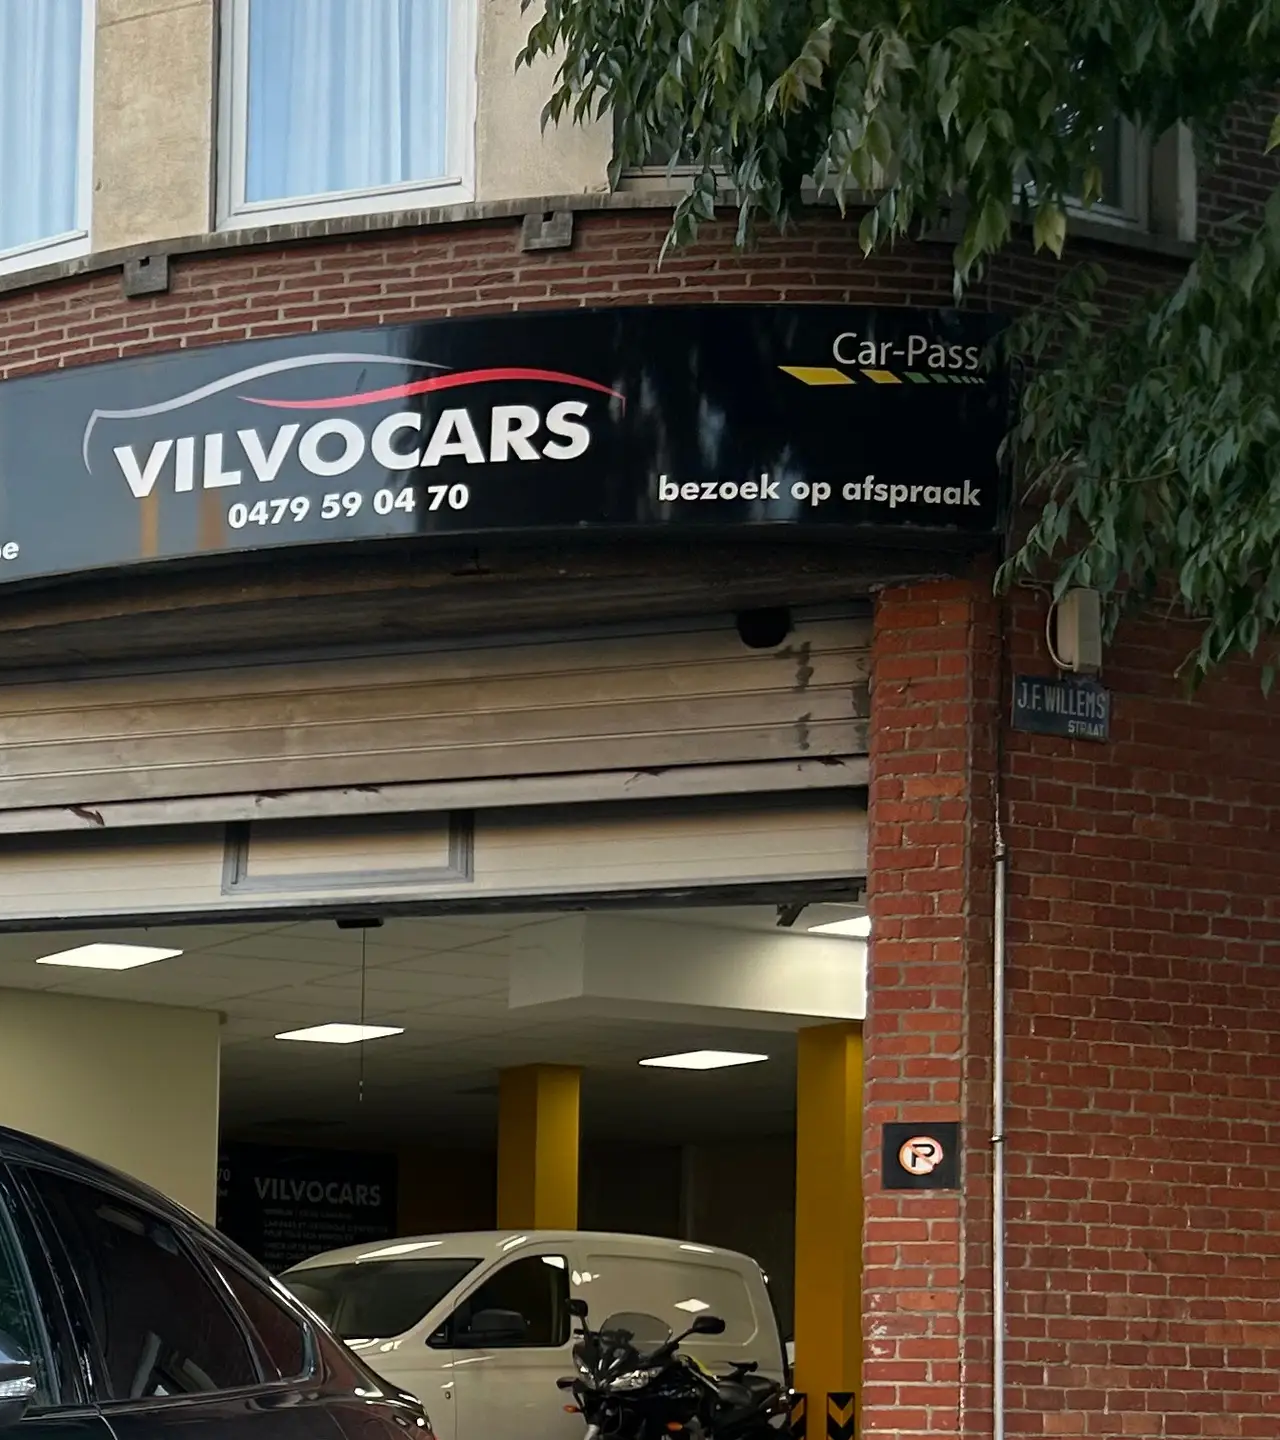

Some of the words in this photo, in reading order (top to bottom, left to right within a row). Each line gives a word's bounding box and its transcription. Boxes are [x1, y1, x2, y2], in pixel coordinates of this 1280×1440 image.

[832, 332, 980, 370] Car-Pass
[113, 400, 590, 498] VILVOCARS
[228, 496, 310, 529] 0479
[320, 493, 362, 520] 59
[372, 489, 415, 515] 04
[427, 484, 470, 511] 70
[658, 475, 780, 502] bezoek
[790, 480, 832, 506] op
[842, 475, 981, 507] afspraak
[1044, 685, 1106, 719] WILLEMS
[1068, 719, 1105, 737] STRAAT
[253, 1177, 381, 1207] VILVOCARS
